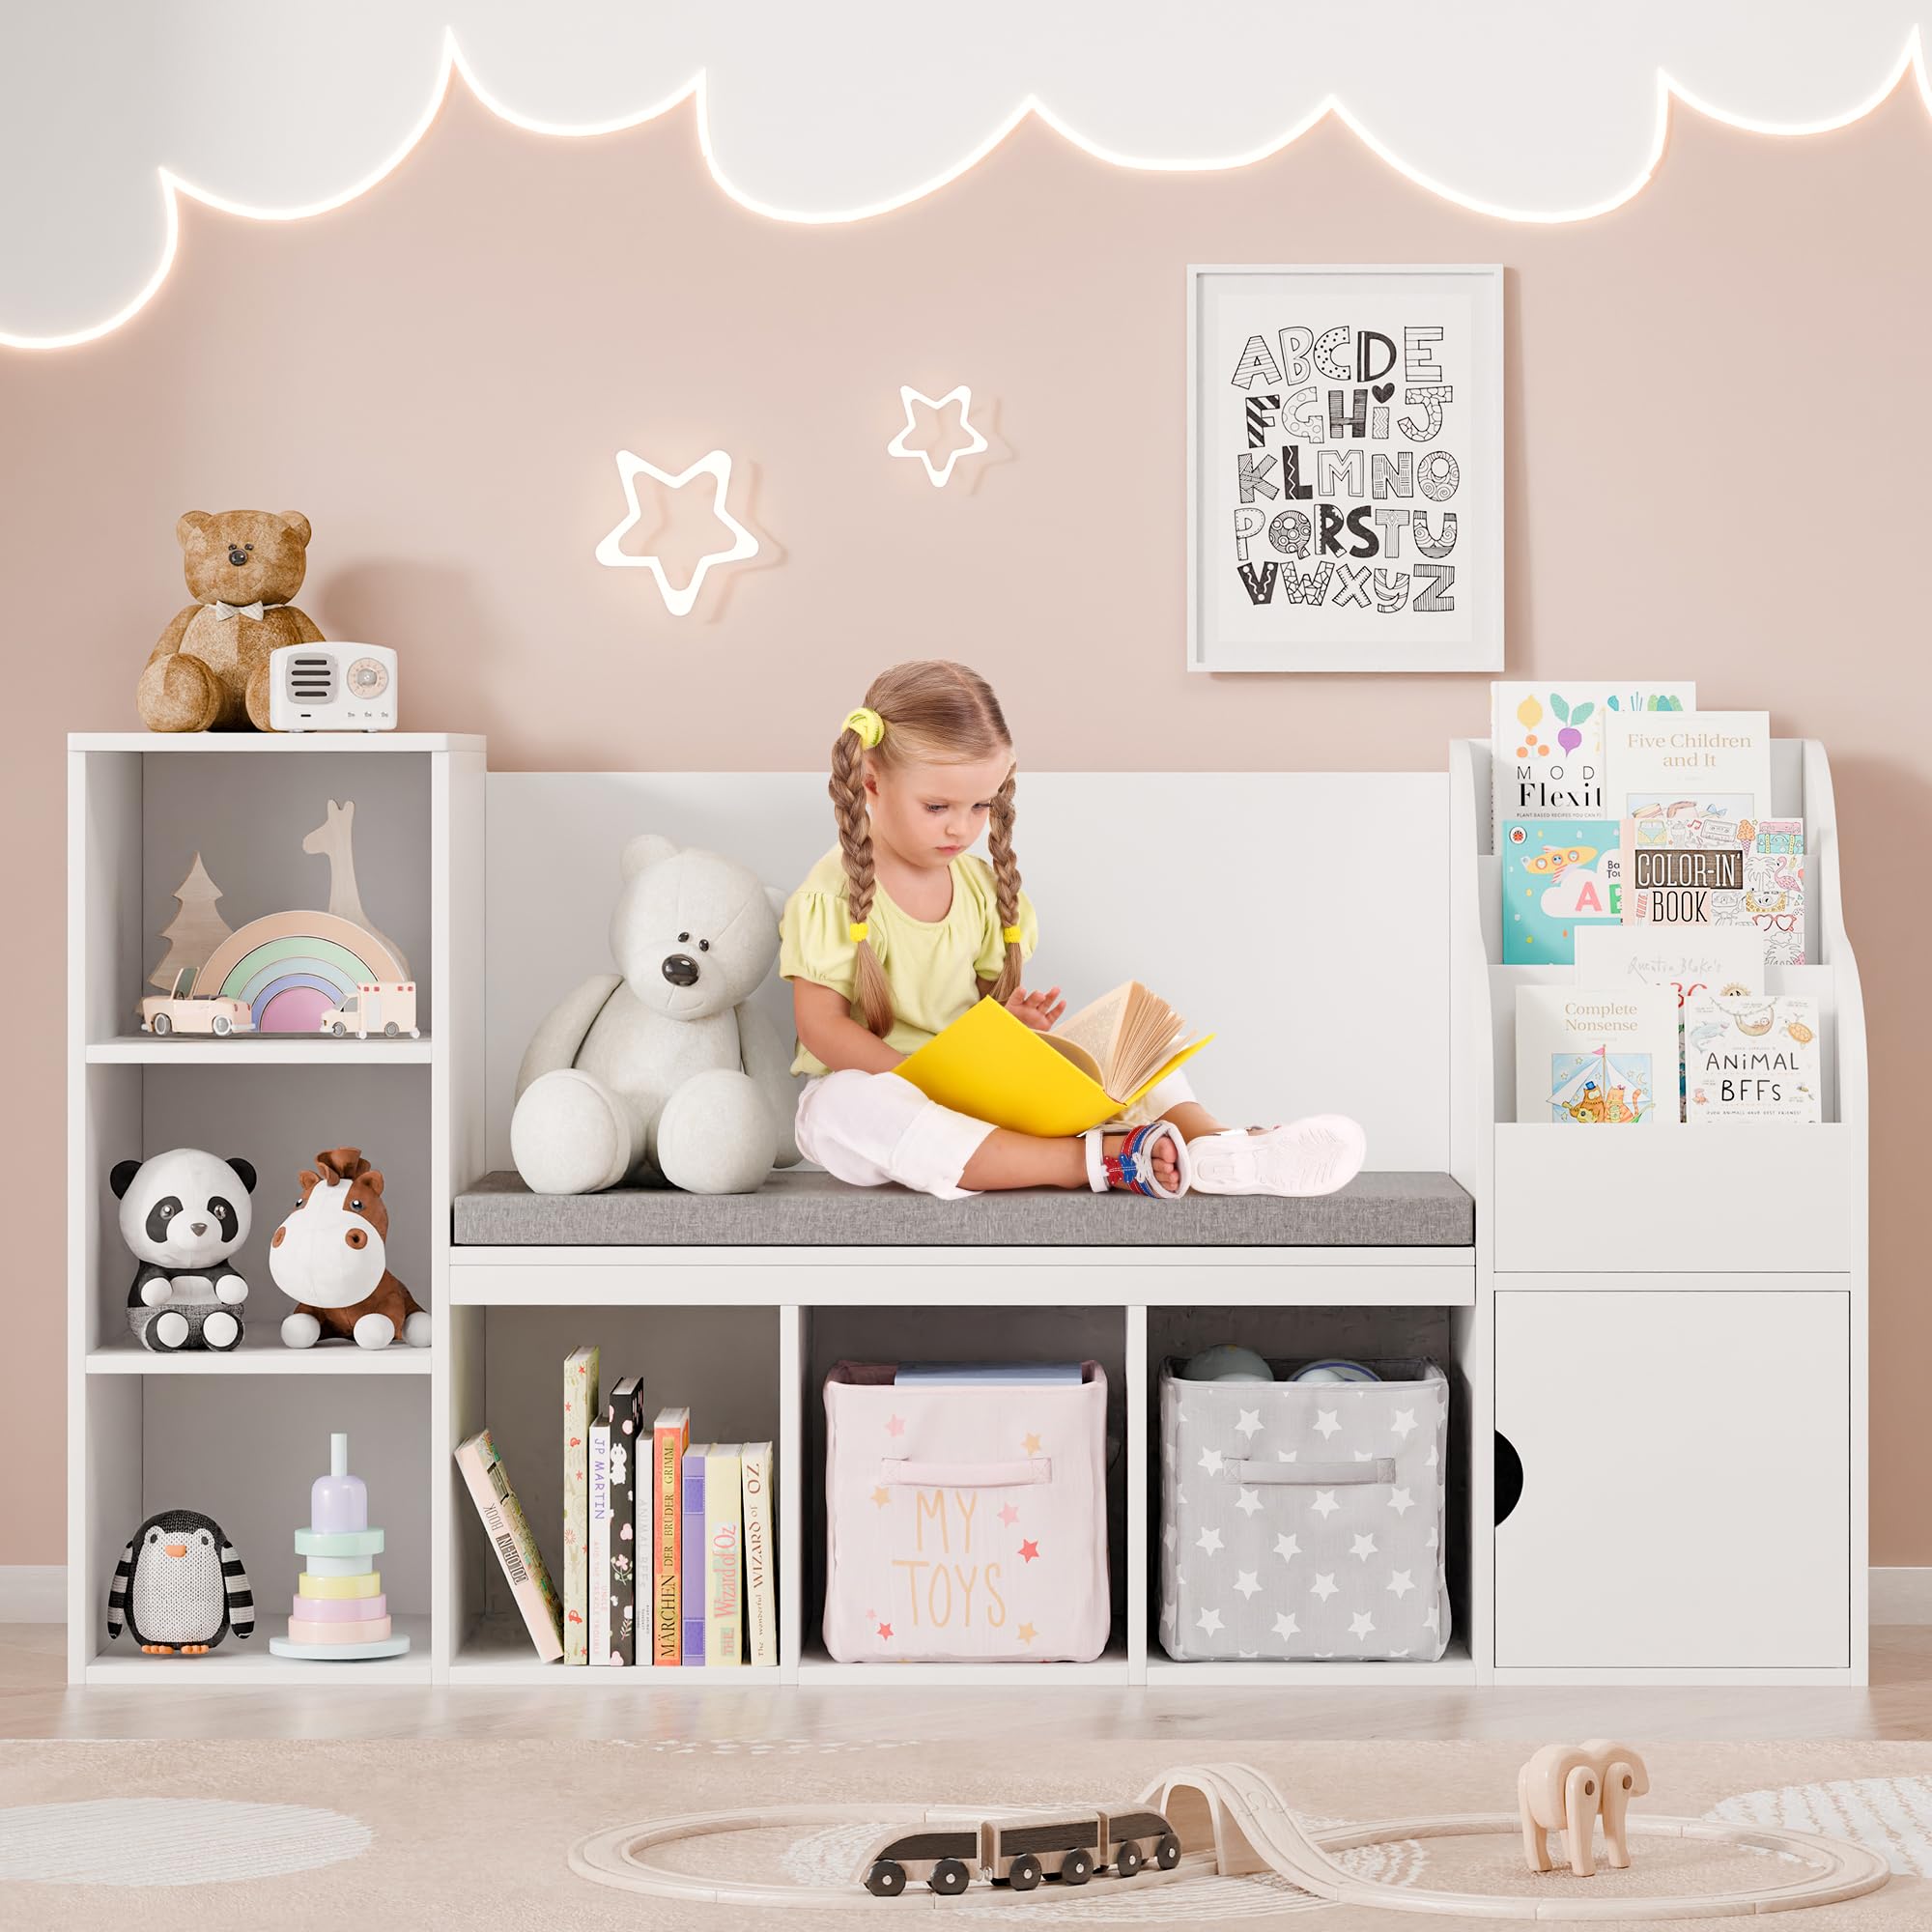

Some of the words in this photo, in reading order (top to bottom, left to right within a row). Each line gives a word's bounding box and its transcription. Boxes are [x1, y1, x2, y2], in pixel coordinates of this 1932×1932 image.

[1237, 445, 1460, 504] KLMNO
[1234, 504, 1458, 561] PQRSTU
[1628, 734, 1665, 749] Five
[1670, 733, 1751, 749] Children
[1662, 753, 1698, 767] and
[1703, 753, 1717, 767] It
[1652, 891, 1708, 923] BOOK
[1565, 1003, 1638, 1018] Complete
[1565, 1019, 1638, 1031] Nonsense
[1720, 1079, 1781, 1102] BFFs
[664, 1447, 673, 1485] GRIMM
[747, 1463, 761, 1494] OZ
[594, 1461, 605, 1520] MARTIN
[483, 1503, 504, 1531] BOOK
[917, 1489, 978, 1554] MY
[664, 1546, 673, 1567] DER
[712, 1569, 737, 1618] Wizard
[892, 1559, 1006, 1628] TOYS
[658, 1575, 675, 1658] MÄRCHEN
